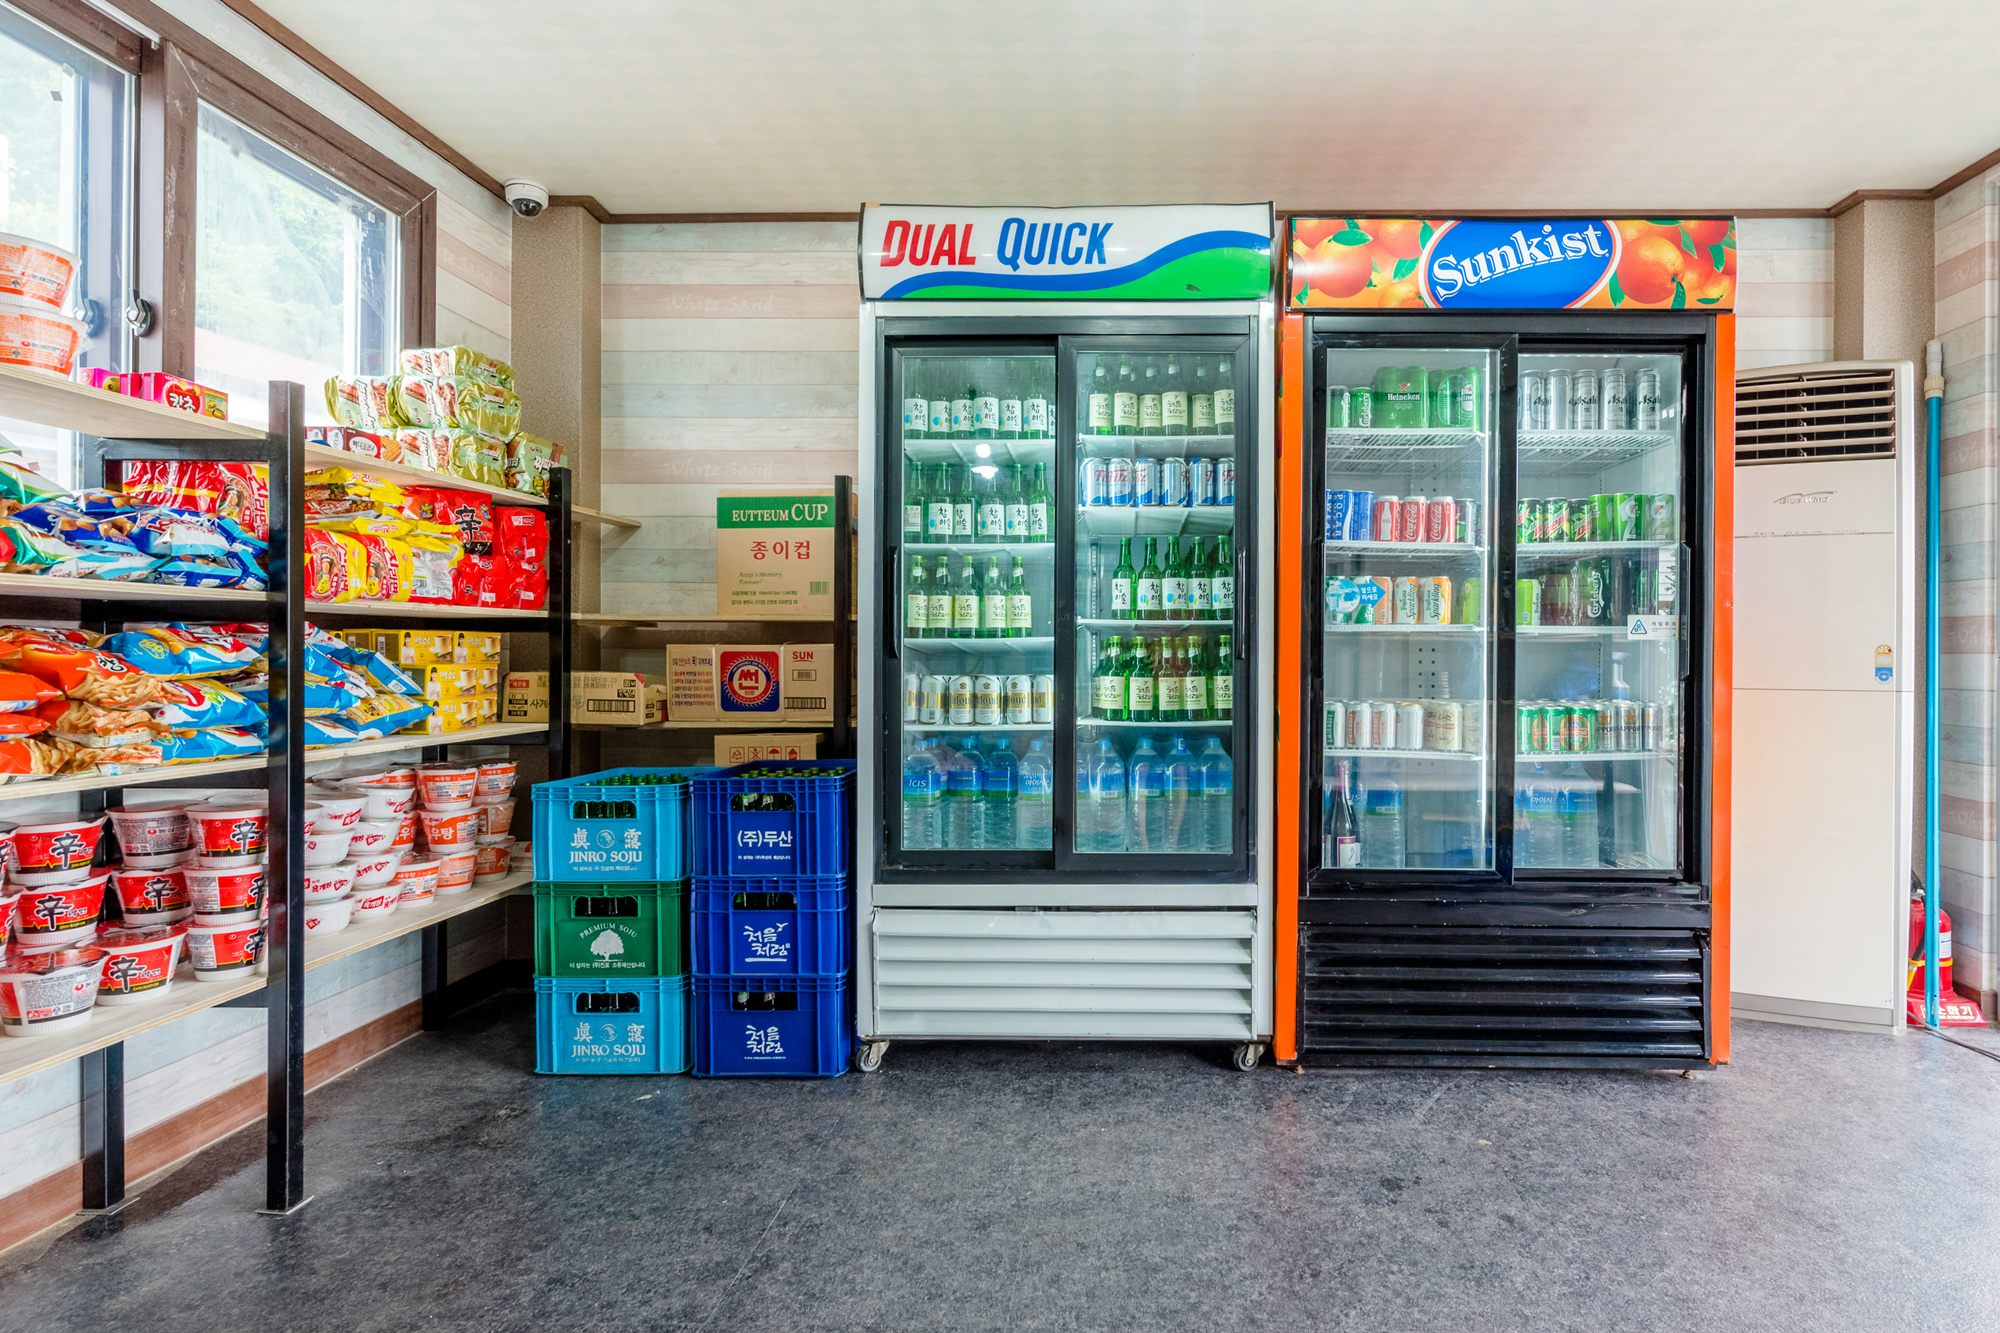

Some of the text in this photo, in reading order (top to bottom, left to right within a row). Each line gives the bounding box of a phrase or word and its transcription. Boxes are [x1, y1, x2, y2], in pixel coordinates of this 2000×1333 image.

[880, 217, 1114, 272] DUAL QUICK
[1429, 224, 1610, 302] Sunkist
[1387, 393, 1420, 401] Heineken
[791, 503, 828, 521] CUP
[1335, 494, 1344, 537] POCAR
[455, 504, 483, 548] 辛
[750, 540, 810, 560] 종이컵
[1587, 570, 1601, 618] Carlsberg
[413, 635, 431, 646] 맥심
[466, 636, 482, 646] 맥심
[792, 651, 814, 660] SUN
[440, 670, 456, 680] 맥심
[738, 669, 759, 690] 썬
[442, 704, 458, 713] 맥심
[230, 820, 262, 854] 辛
[431, 827, 454, 840] 우탕
[737, 830, 793, 847] (주)두산
[50, 832, 86, 870] 辛
[569, 851, 642, 864] JINRO SOJU
[145, 877, 178, 911] 辛
[34, 894, 74, 932] 辛
[579, 923, 638, 939] PREMIUM SOJU
[743, 926, 777, 943] 처음
[751, 943, 788, 957] 처럼
[109, 956, 147, 993] 辛
[745, 1025, 780, 1042] 처음
[571, 1044, 646, 1058] JINRO SOJU
[746, 1041, 784, 1055] 처럼
